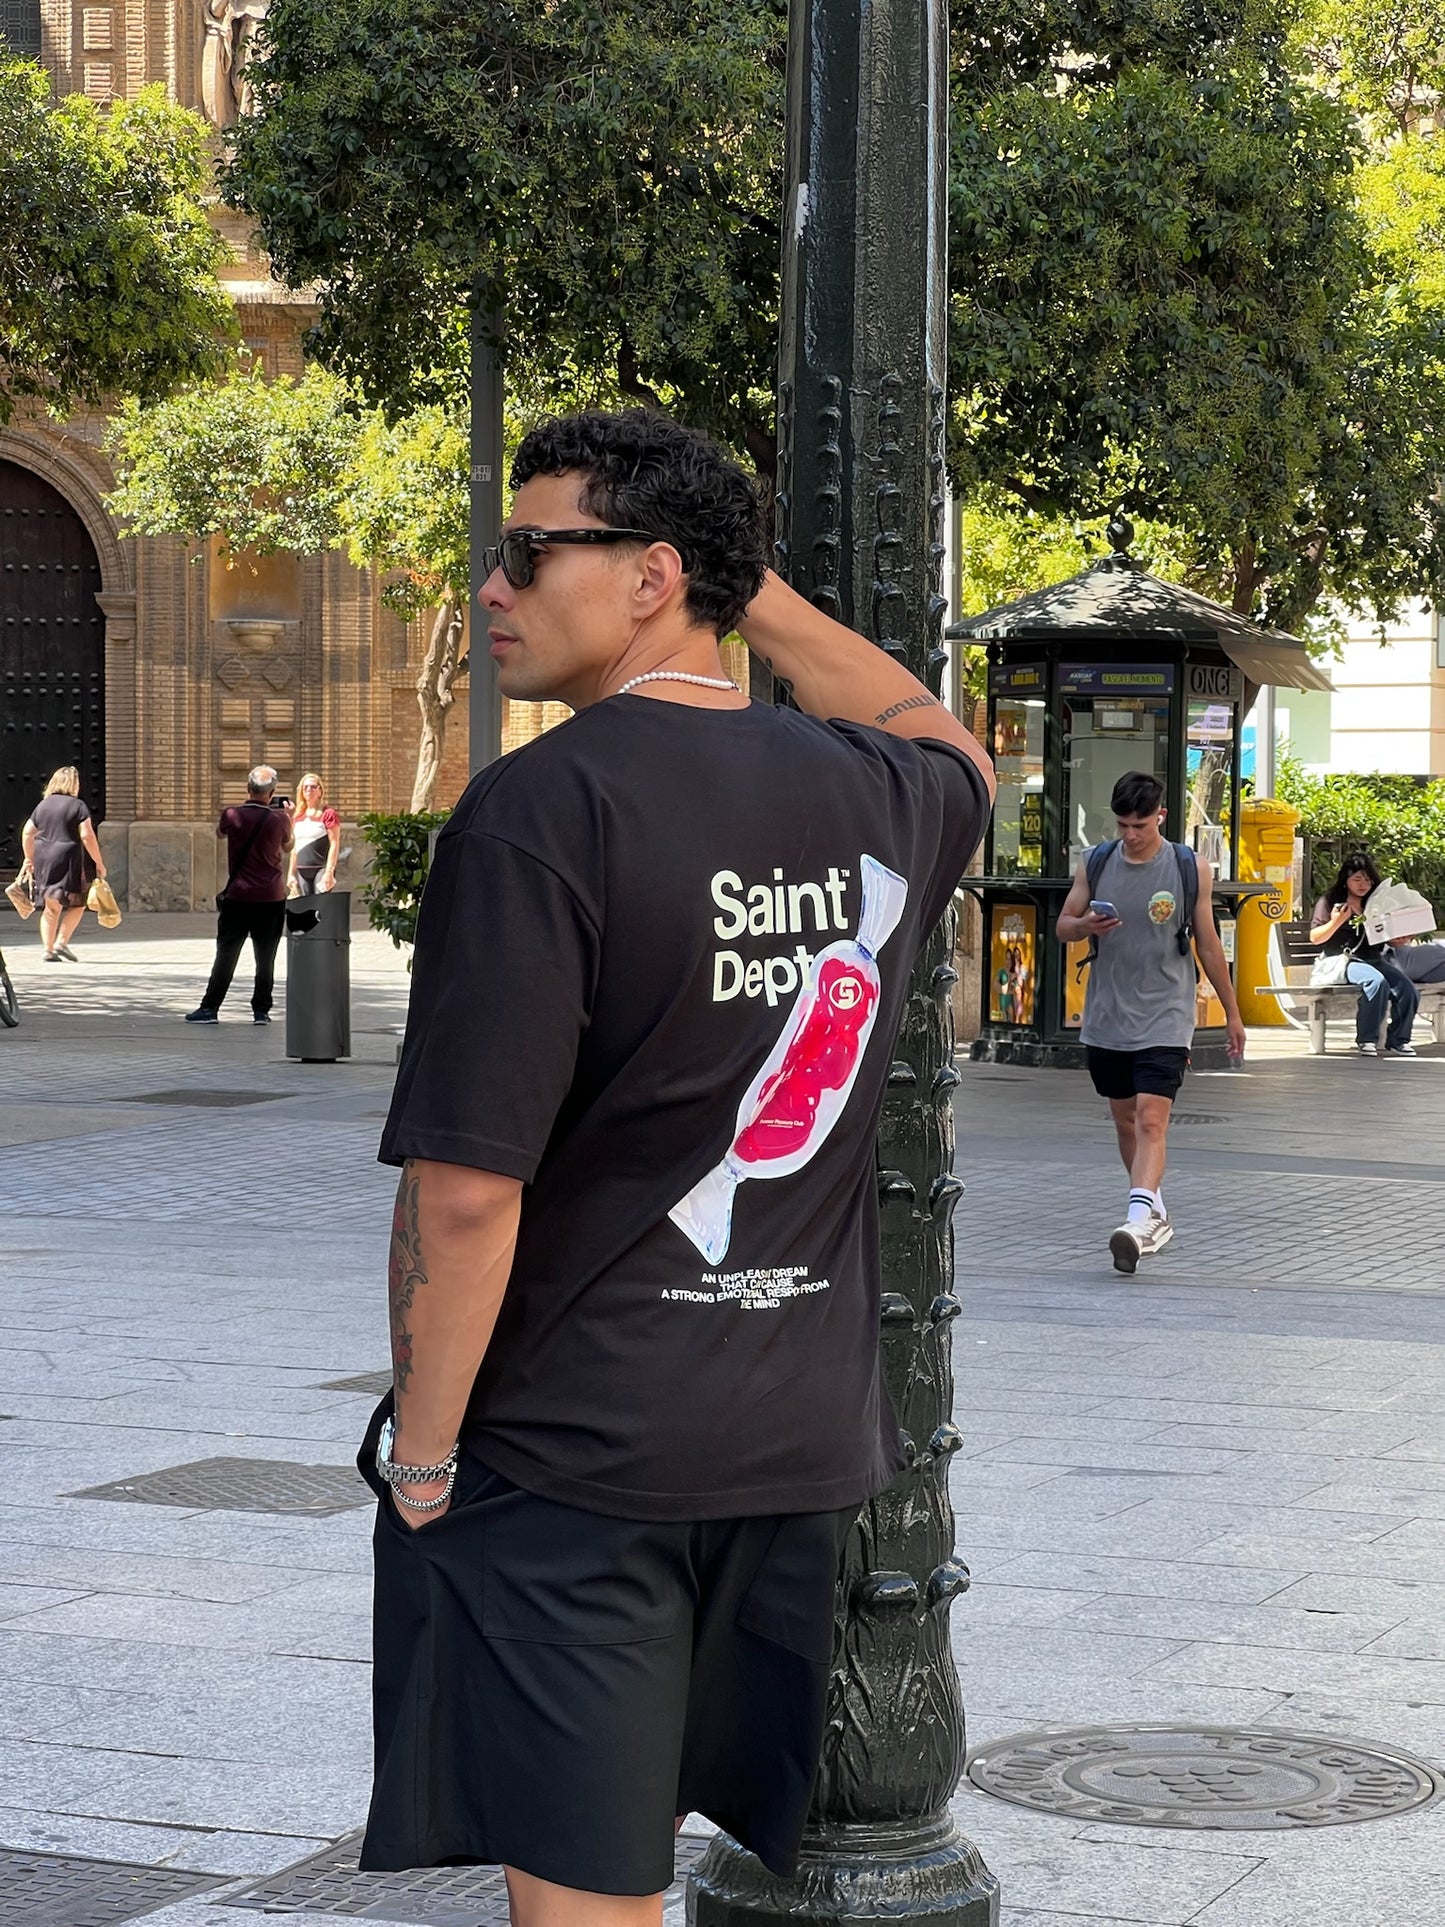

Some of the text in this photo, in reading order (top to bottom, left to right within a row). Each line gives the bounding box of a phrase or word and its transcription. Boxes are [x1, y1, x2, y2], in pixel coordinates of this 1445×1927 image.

[1023, 814, 1041, 832] 120
[711, 867, 849, 940] Saint
[712, 945, 815, 1007] Dept
[701, 1272, 717, 1284] AN
[720, 1279, 748, 1292] THAT
[761, 1277, 795, 1290] CAUSE
[661, 1288, 670, 1299] A
[670, 1289, 715, 1303] STRONG
[800, 1278, 830, 1294] FROM
[753, 1299, 781, 1310] MIND
